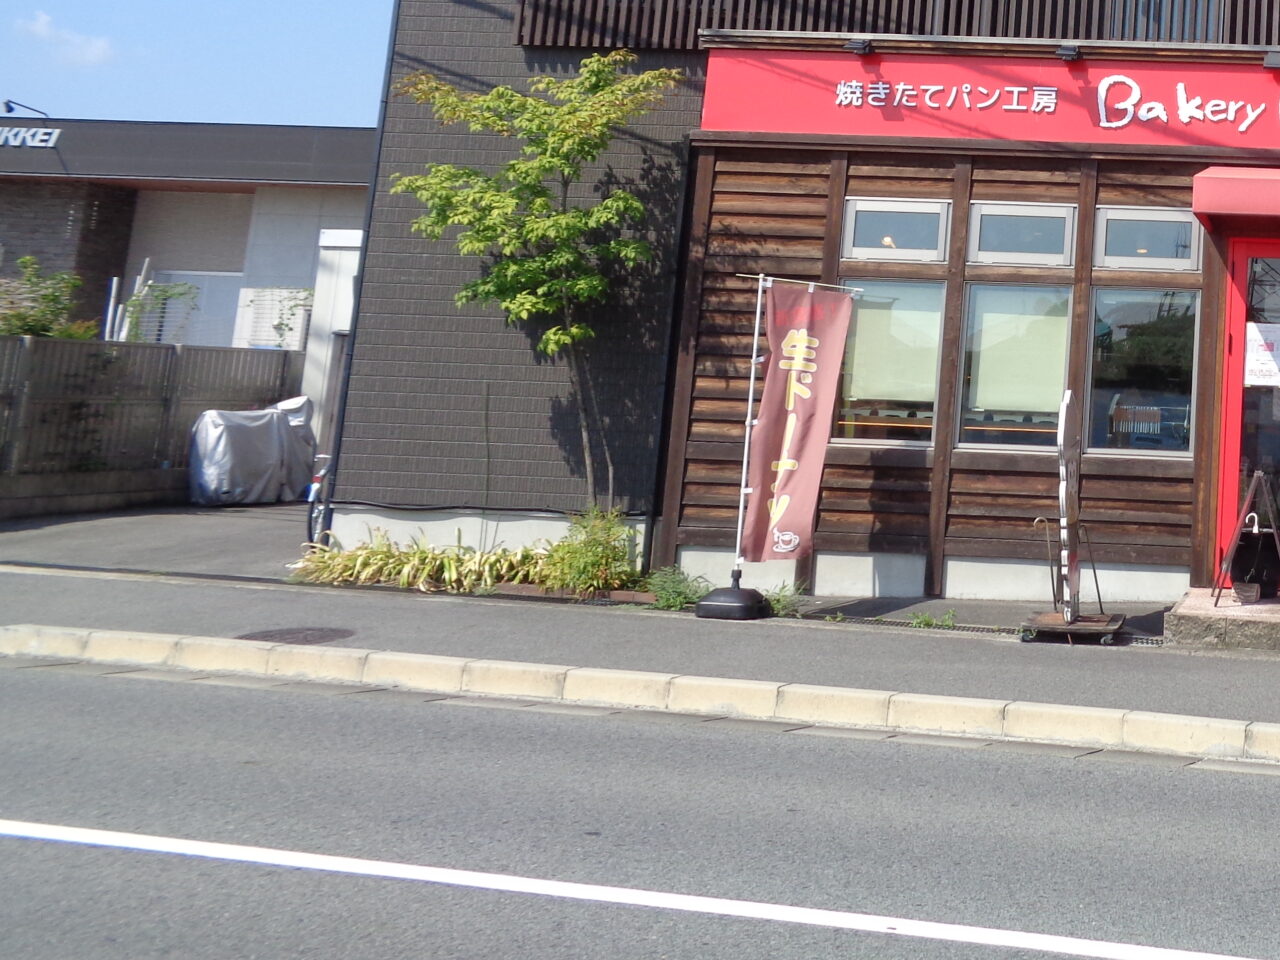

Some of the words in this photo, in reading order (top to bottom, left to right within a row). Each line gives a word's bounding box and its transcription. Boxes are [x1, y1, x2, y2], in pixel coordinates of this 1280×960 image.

[835, 80, 1058, 112] 焼きたてパン工房
[1098, 75, 1266, 132] Bakery
